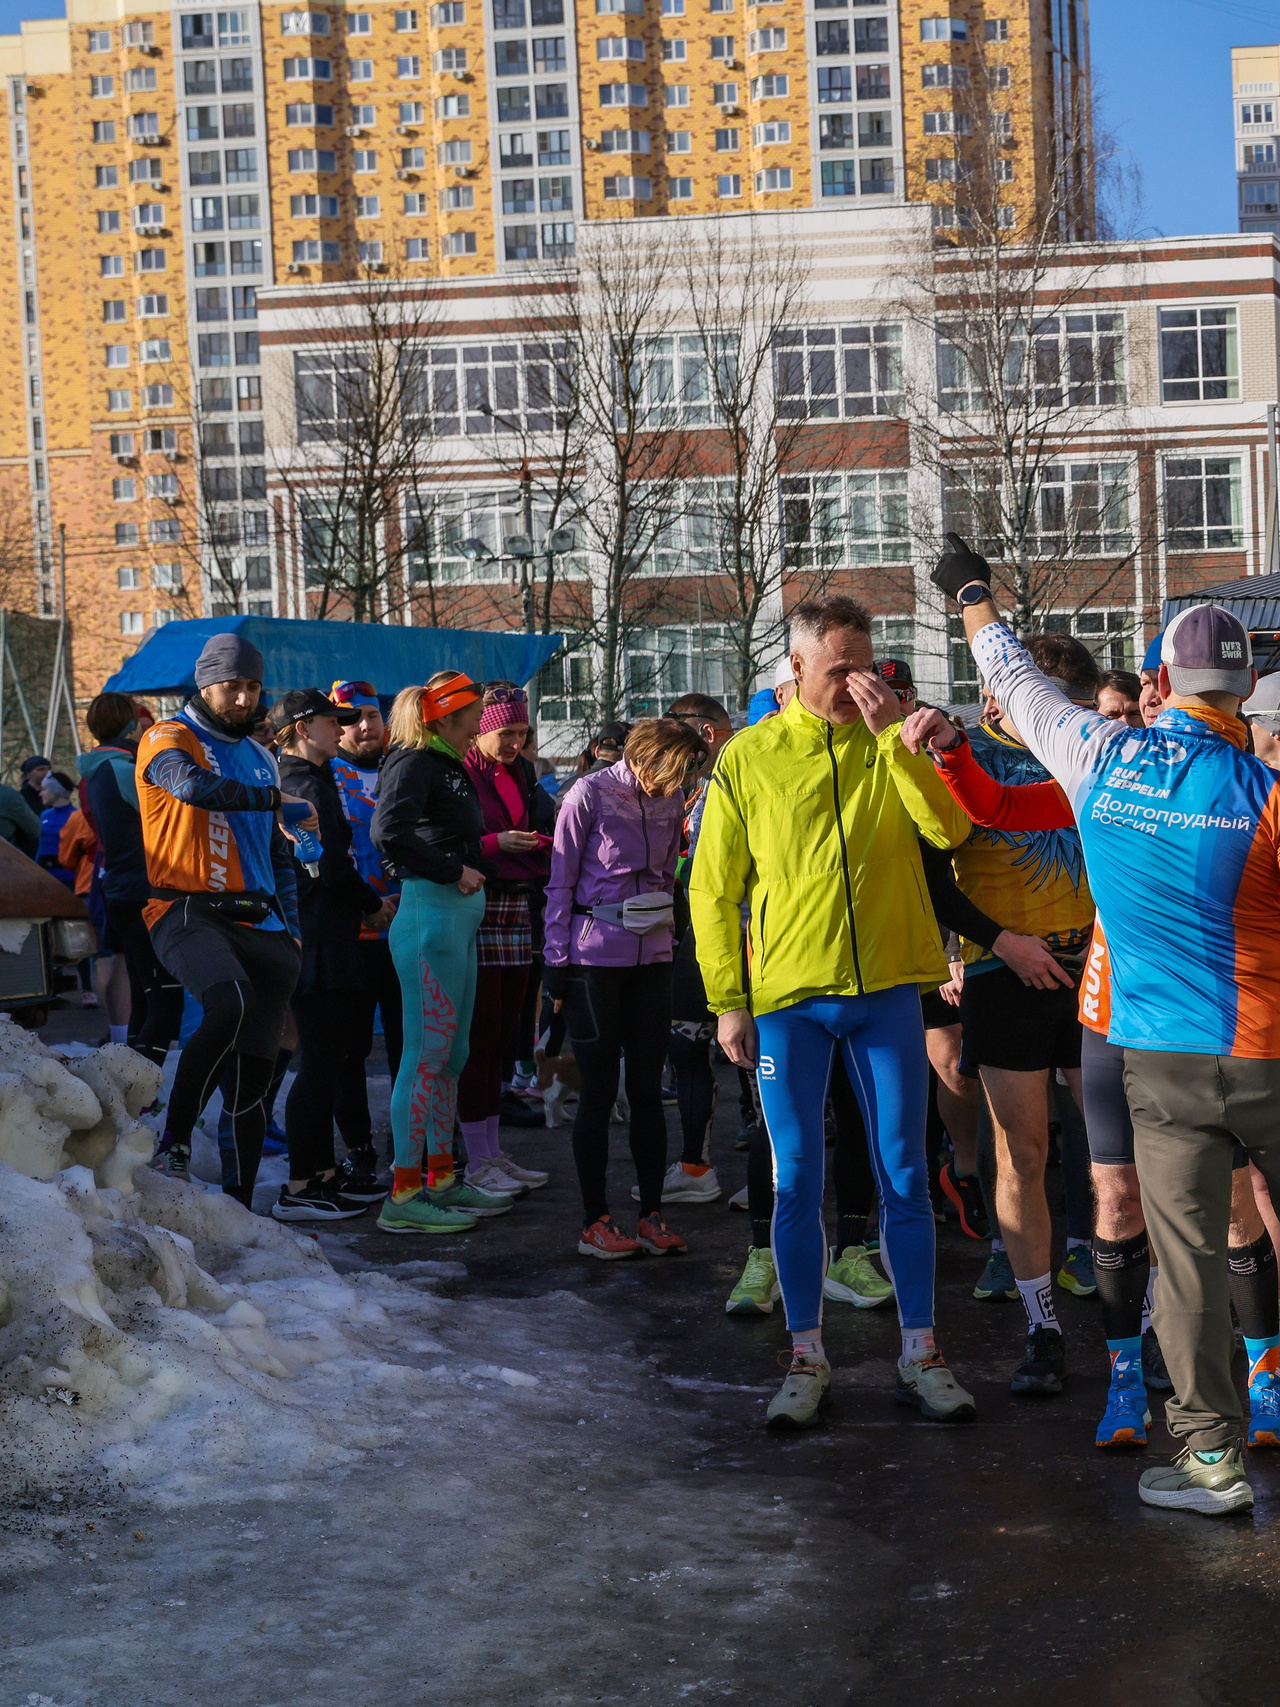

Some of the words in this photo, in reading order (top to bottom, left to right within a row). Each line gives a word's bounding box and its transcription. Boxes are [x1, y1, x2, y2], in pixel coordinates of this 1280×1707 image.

[1104, 777, 1171, 799] ZEPPELIN
[1111, 766, 1143, 782] RUN
[1091, 810, 1158, 836] РОССИЯ
[1092, 792, 1250, 831] Долгопрудный
[206, 862, 228, 893] UN
[1083, 940, 1105, 1022] RUN
